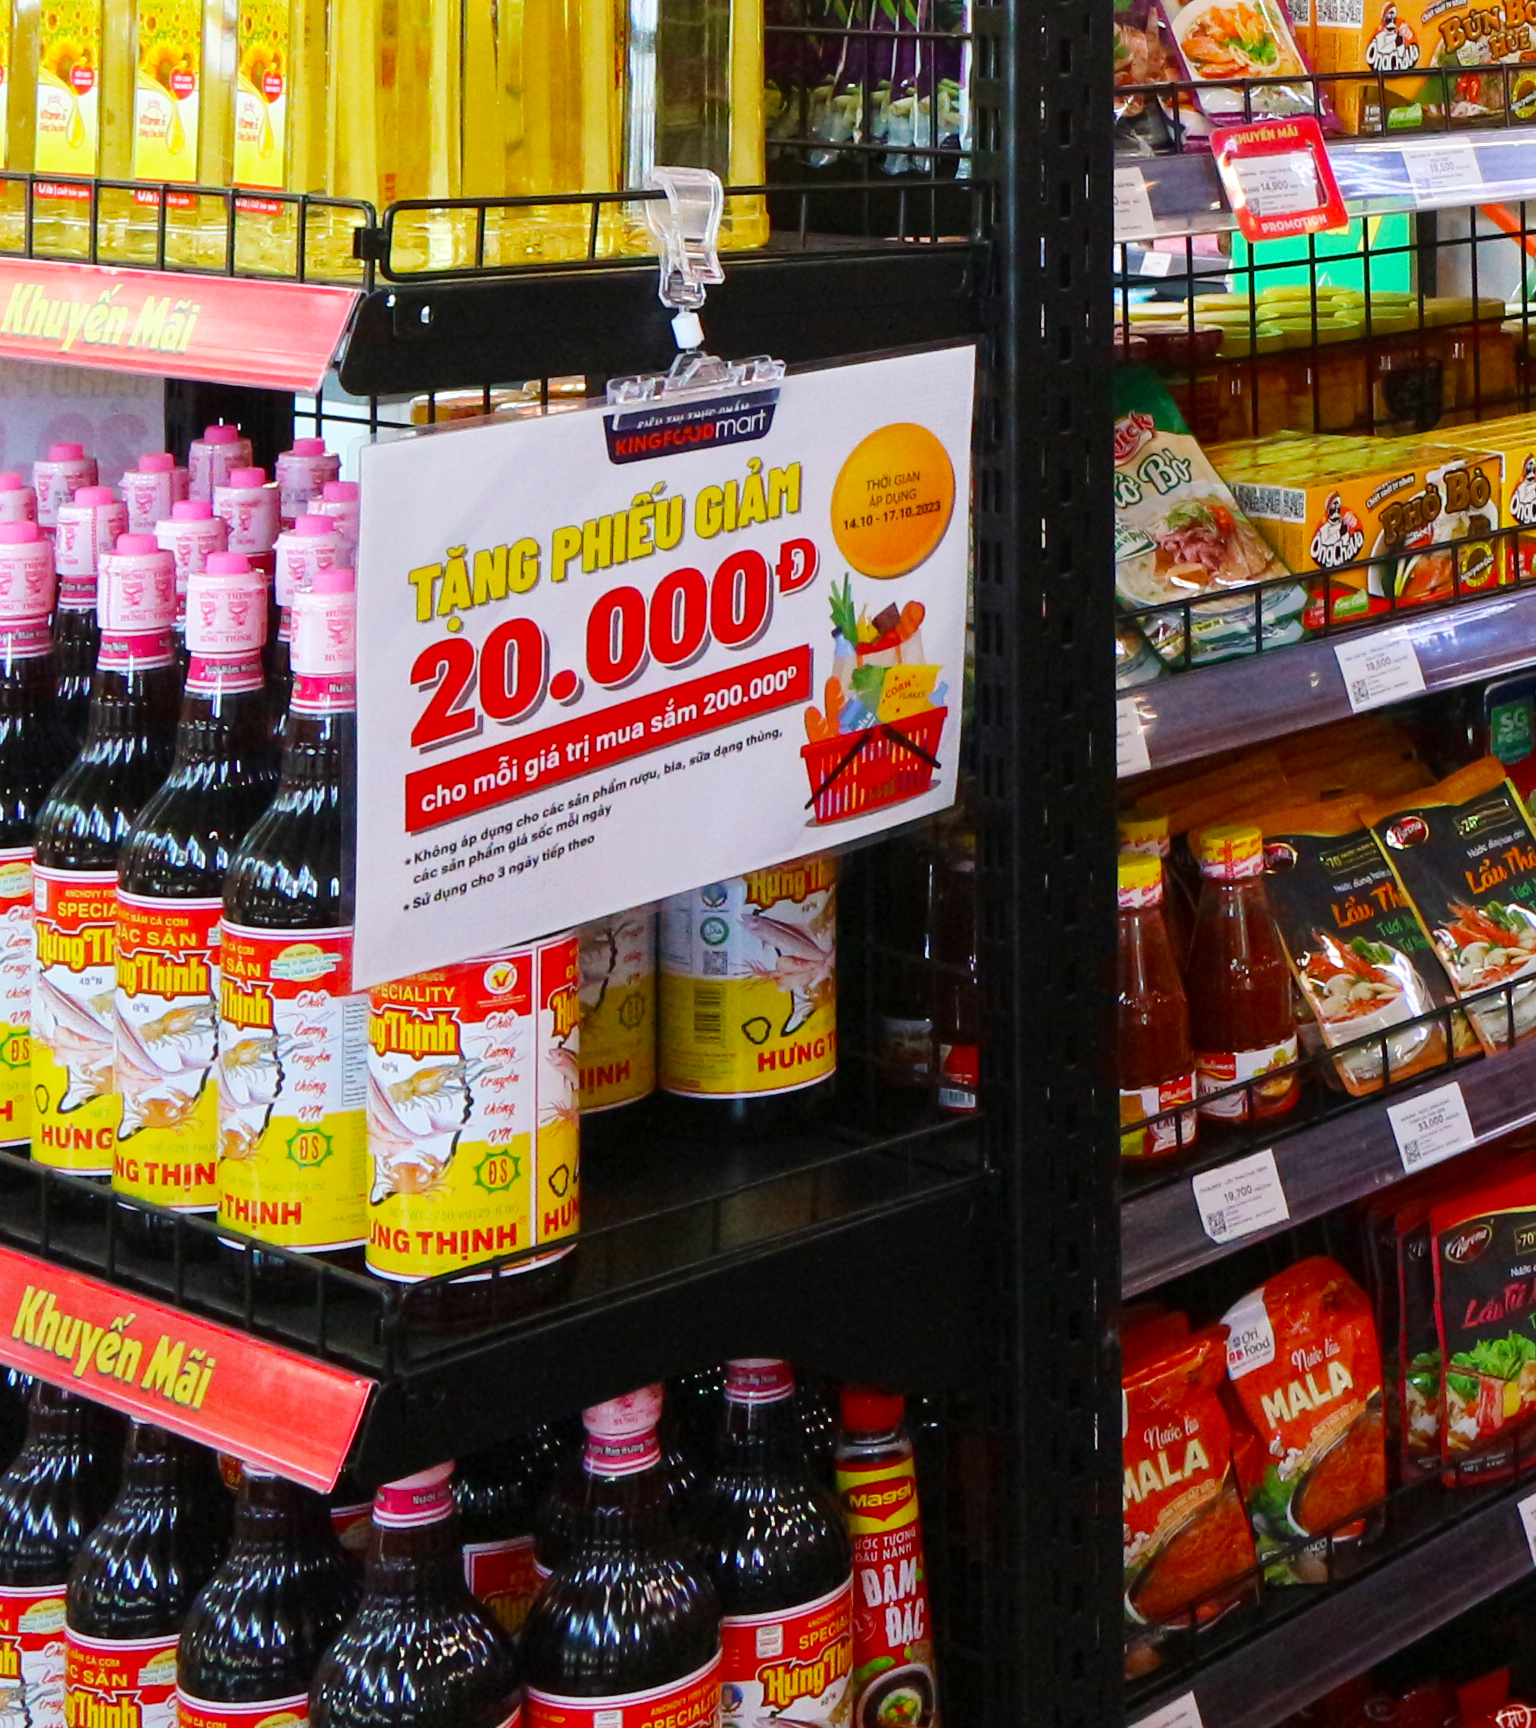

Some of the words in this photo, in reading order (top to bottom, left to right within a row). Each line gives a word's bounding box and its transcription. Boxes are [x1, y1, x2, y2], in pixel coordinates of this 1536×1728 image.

[1261, 213, 1328, 235] PROMOTION
[1, 280, 129, 354] Khuyến
[135, 295, 201, 355] Mãi
[615, 409, 767, 456] KINGFOODmart
[866, 475, 893, 492] THỜI
[894, 470, 922, 486] GIAN
[868, 494, 884, 508] ÁP
[885, 488, 917, 505] DỤNG
[843, 516, 874, 531] 14.10
[883, 499, 942, 524] 17.10.2023
[408, 543, 542, 633] TẶNG
[551, 481, 685, 583] PHIẾU
[694, 456, 802, 539] GIẢM
[421, 780, 468, 813] cho
[473, 755, 519, 796] mỗi
[524, 745, 562, 781] giá
[566, 735, 591, 764] trị
[595, 722, 645, 754] mua
[650, 697, 698, 735] sắm
[413, 839, 458, 866] Không
[460, 833, 478, 851] áp
[480, 820, 513, 842] dụng
[515, 810, 540, 830] cho
[541, 803, 565, 820] các
[592, 779, 628, 804] phẩm
[713, 738, 744, 760] dạng
[412, 868, 439, 886] các
[468, 842, 506, 871] phẩm
[507, 837, 529, 858] giá
[530, 822, 554, 843] sốc
[555, 811, 580, 832] mỗi
[582, 803, 613, 825] ngày
[412, 891, 431, 911] Sử
[432, 884, 468, 906] dụng
[470, 872, 496, 890] cho
[497, 866, 506, 880] 3
[508, 856, 539, 879] ngày
[541, 841, 566, 863] tiếp
[567, 834, 596, 852] theo
[137, 952, 208, 1001] Thịnh
[296, 992, 327, 1008] Chất
[485, 1012, 515, 1029] Chất
[758, 1040, 826, 1073] HƯNG
[222, 1199, 303, 1231] THỊNH
[418, 1224, 519, 1260] THỊNH
[11, 1283, 145, 1402] Khuyến
[141, 1332, 218, 1411] Mãi
[1241, 1328, 1260, 1348] Ori
[1243, 1338, 1272, 1360] Food
[1260, 1365, 1355, 1432] MALA
[850, 1484, 912, 1508] Maggi
[861, 1557, 918, 1608] ĐẬM
